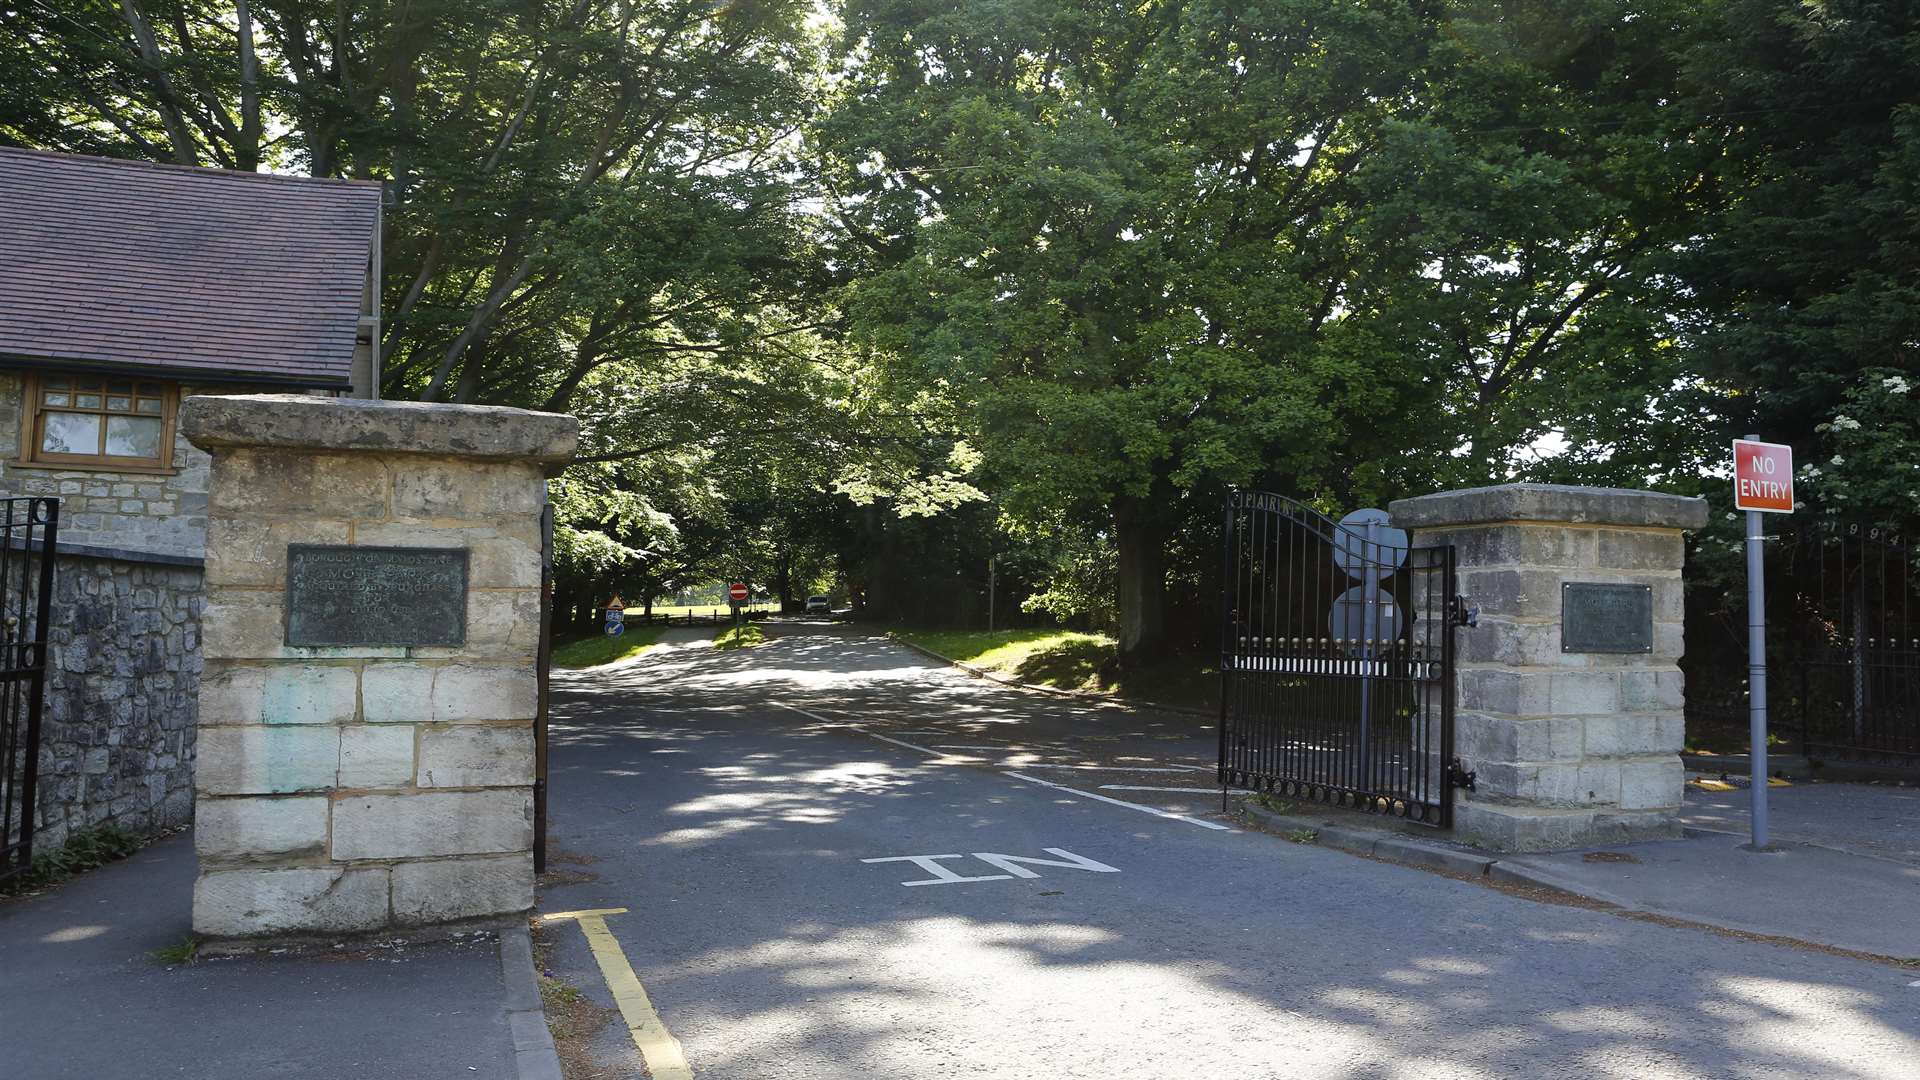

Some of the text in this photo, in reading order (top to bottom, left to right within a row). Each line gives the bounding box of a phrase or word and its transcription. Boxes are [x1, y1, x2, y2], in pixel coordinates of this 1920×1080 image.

[1752, 455, 1776, 475] NO
[1740, 478, 1788, 500] ENTRY
[1246, 492, 1291, 516] PARK
[859, 847, 1122, 887] IN
